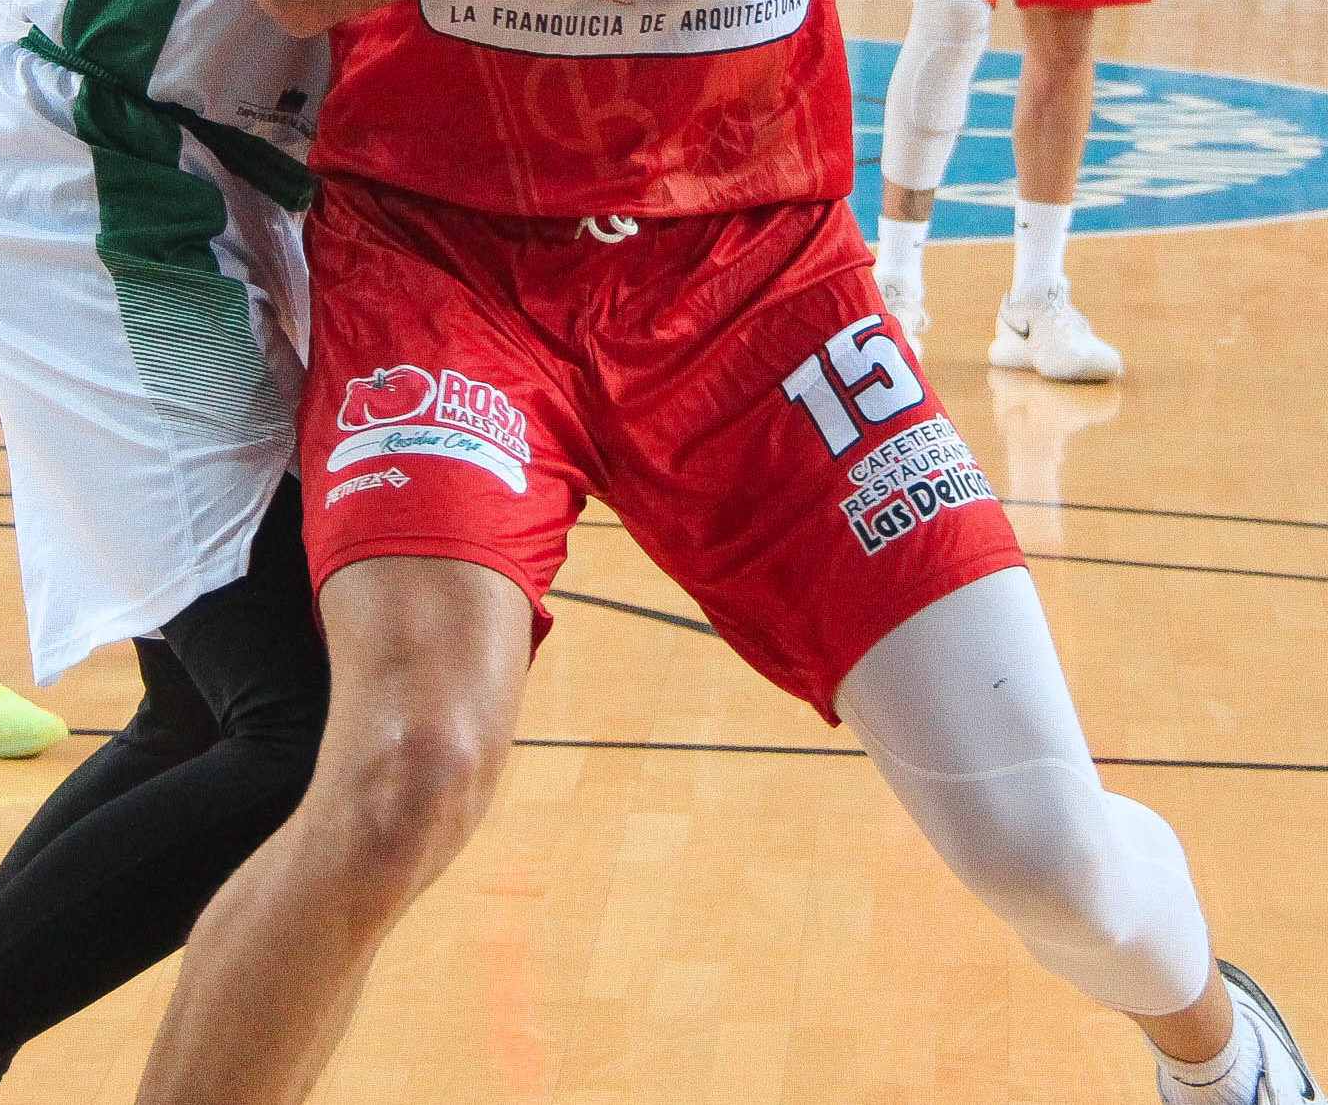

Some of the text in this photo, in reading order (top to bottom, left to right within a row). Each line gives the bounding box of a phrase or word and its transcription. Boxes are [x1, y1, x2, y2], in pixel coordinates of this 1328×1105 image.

[451, 5, 476, 23] LA
[492, 7, 624, 36] FRANQUICIA
[639, 13, 667, 33] DE
[781, 313, 926, 460] 15
[844, 443, 968, 519] RESTAURAN
[853, 501, 913, 553] Las
